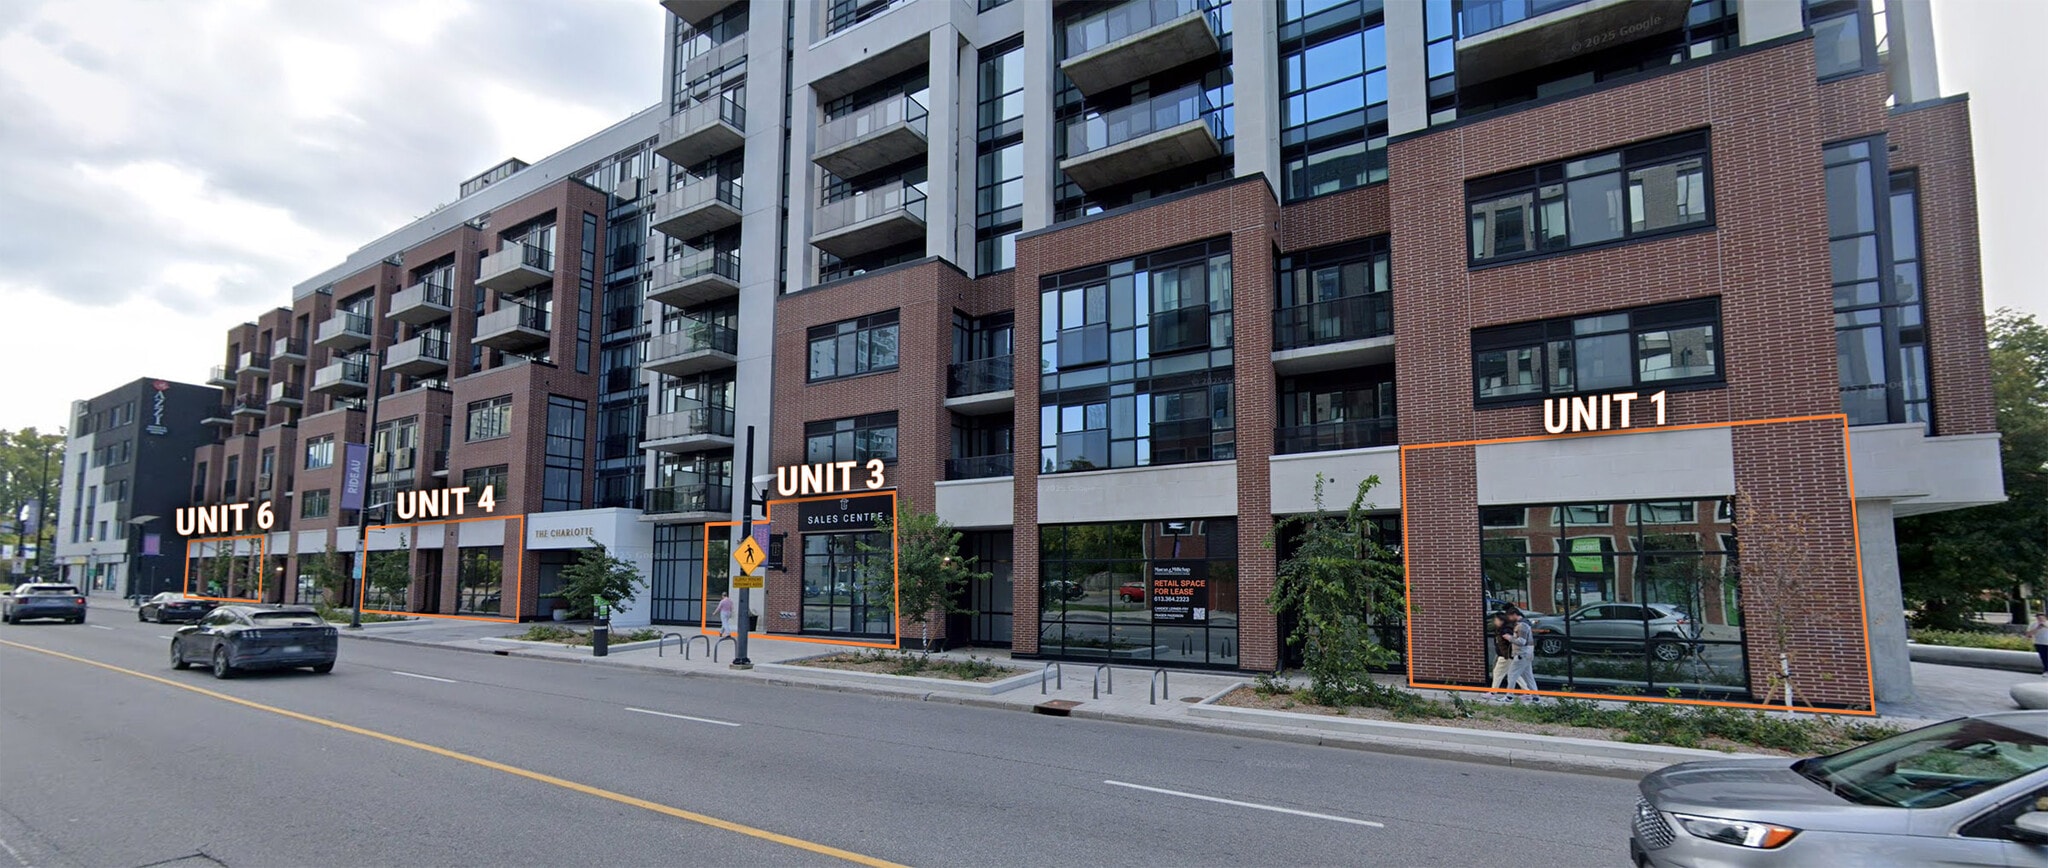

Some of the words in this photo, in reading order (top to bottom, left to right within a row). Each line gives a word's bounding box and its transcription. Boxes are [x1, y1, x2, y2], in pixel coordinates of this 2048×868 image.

[347, 460, 361, 494] RIDEAU
[807, 514, 838, 525] SALES
[535, 529, 548, 538] THE
[550, 526, 594, 538] CHARLOTTE
